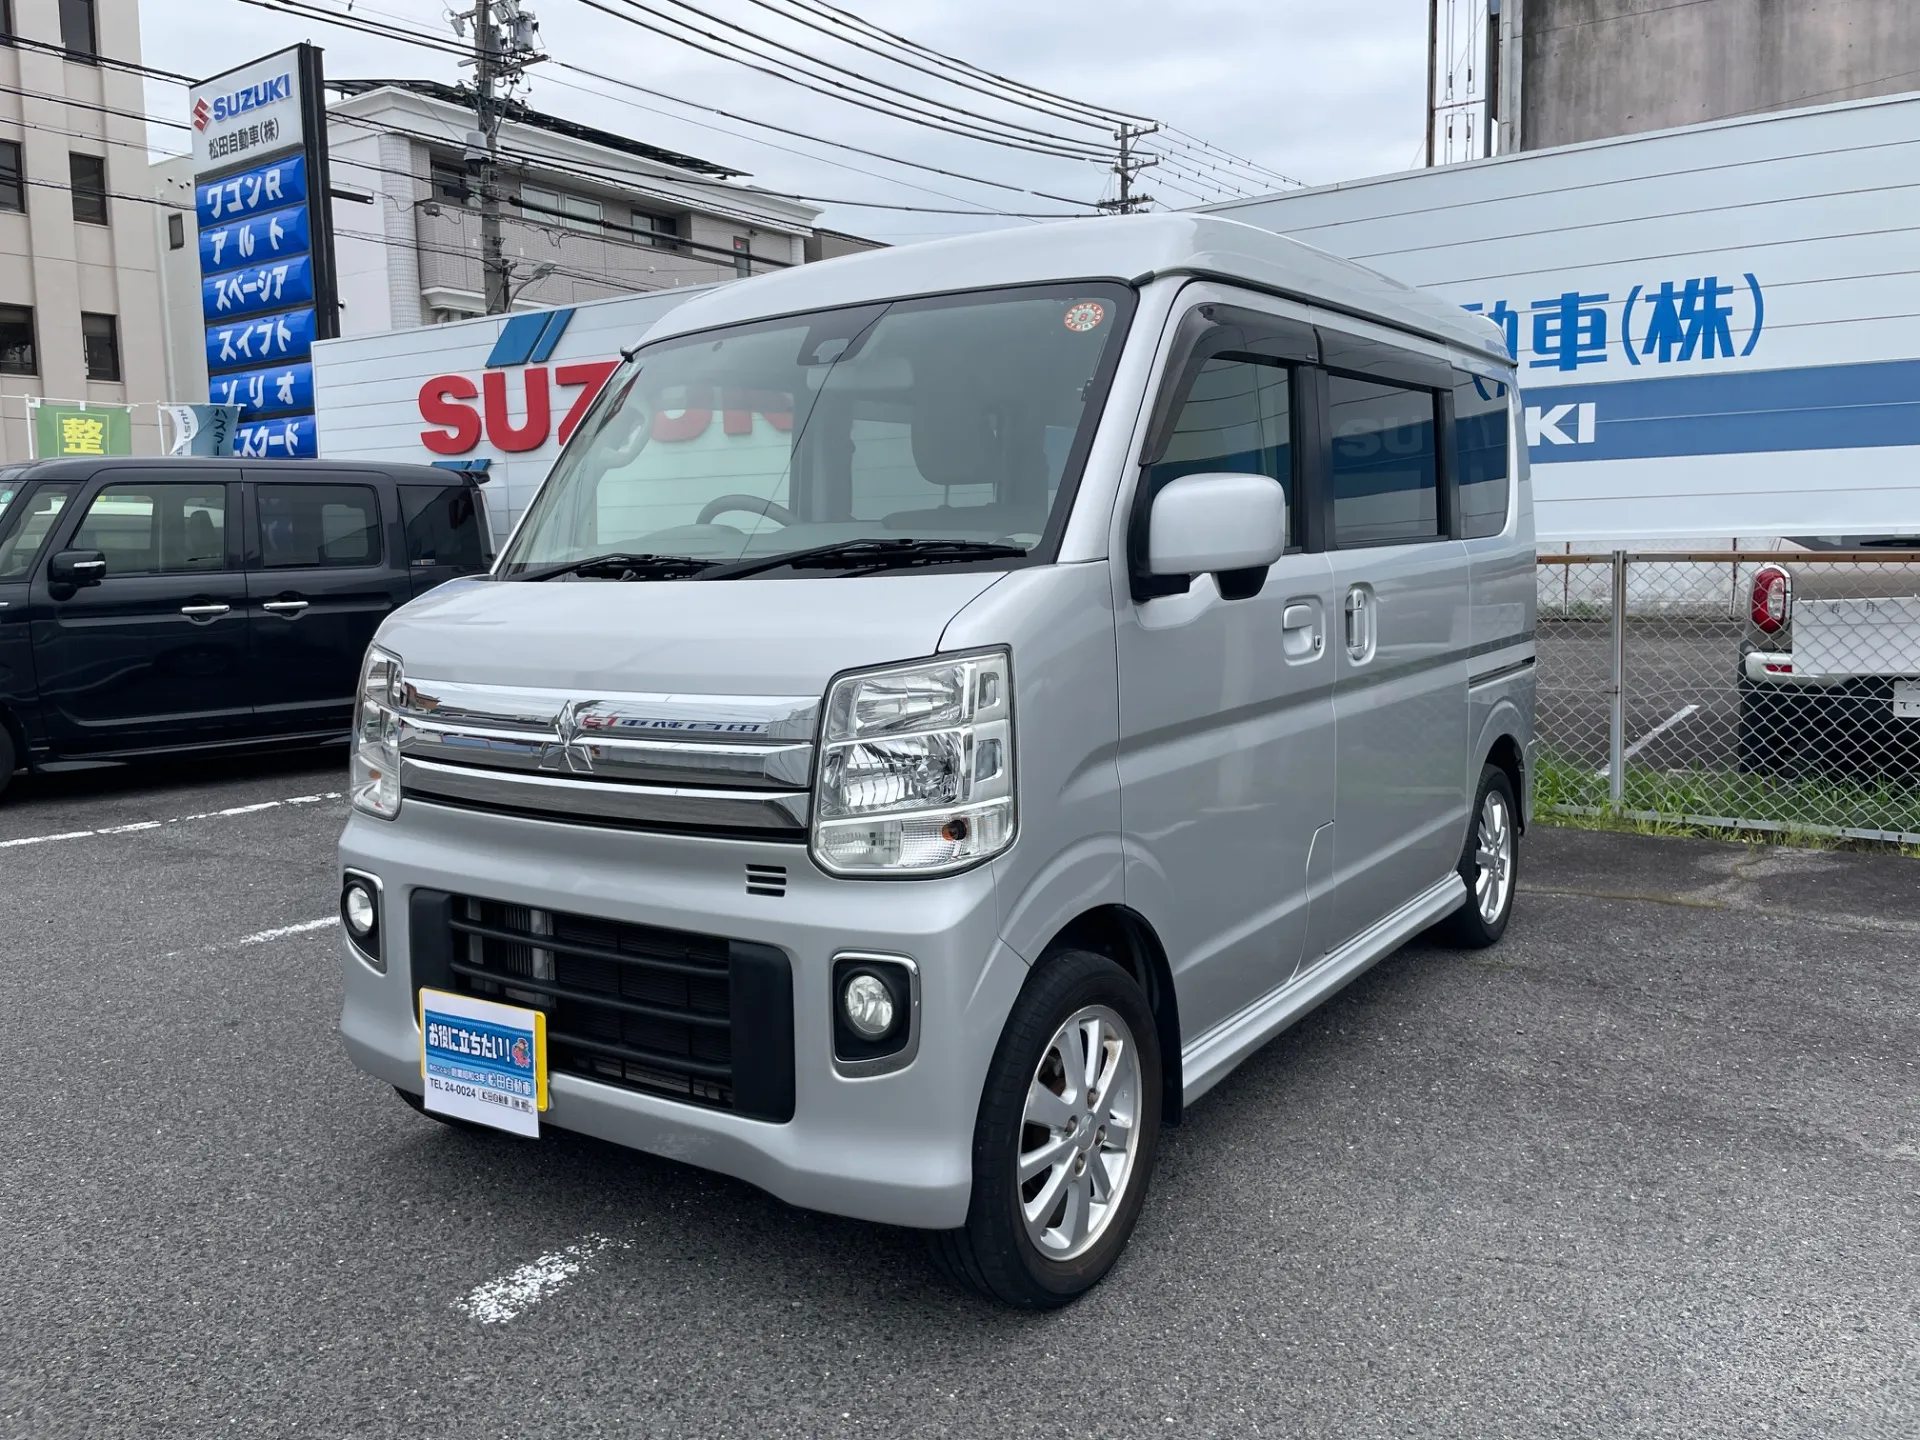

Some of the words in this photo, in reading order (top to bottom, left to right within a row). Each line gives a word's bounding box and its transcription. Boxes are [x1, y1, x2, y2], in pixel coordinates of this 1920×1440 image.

[213, 73, 291, 121] SUZUKI
[208, 118, 280, 160] 松田自動車(株)
[207, 169, 284, 218] ワゴンR
[211, 217, 284, 265] アルト
[215, 265, 289, 311] スペーシア
[219, 320, 292, 361] スイフト
[222, 371, 295, 408] ソリオ
[62, 417, 104, 454] 整
[429, 1023, 510, 1062] お役に立ちたい！
[429, 1077, 443, 1090] TEL
[445, 1081, 476, 1098] 24-0024
[487, 1071, 531, 1095] 松田自動車
